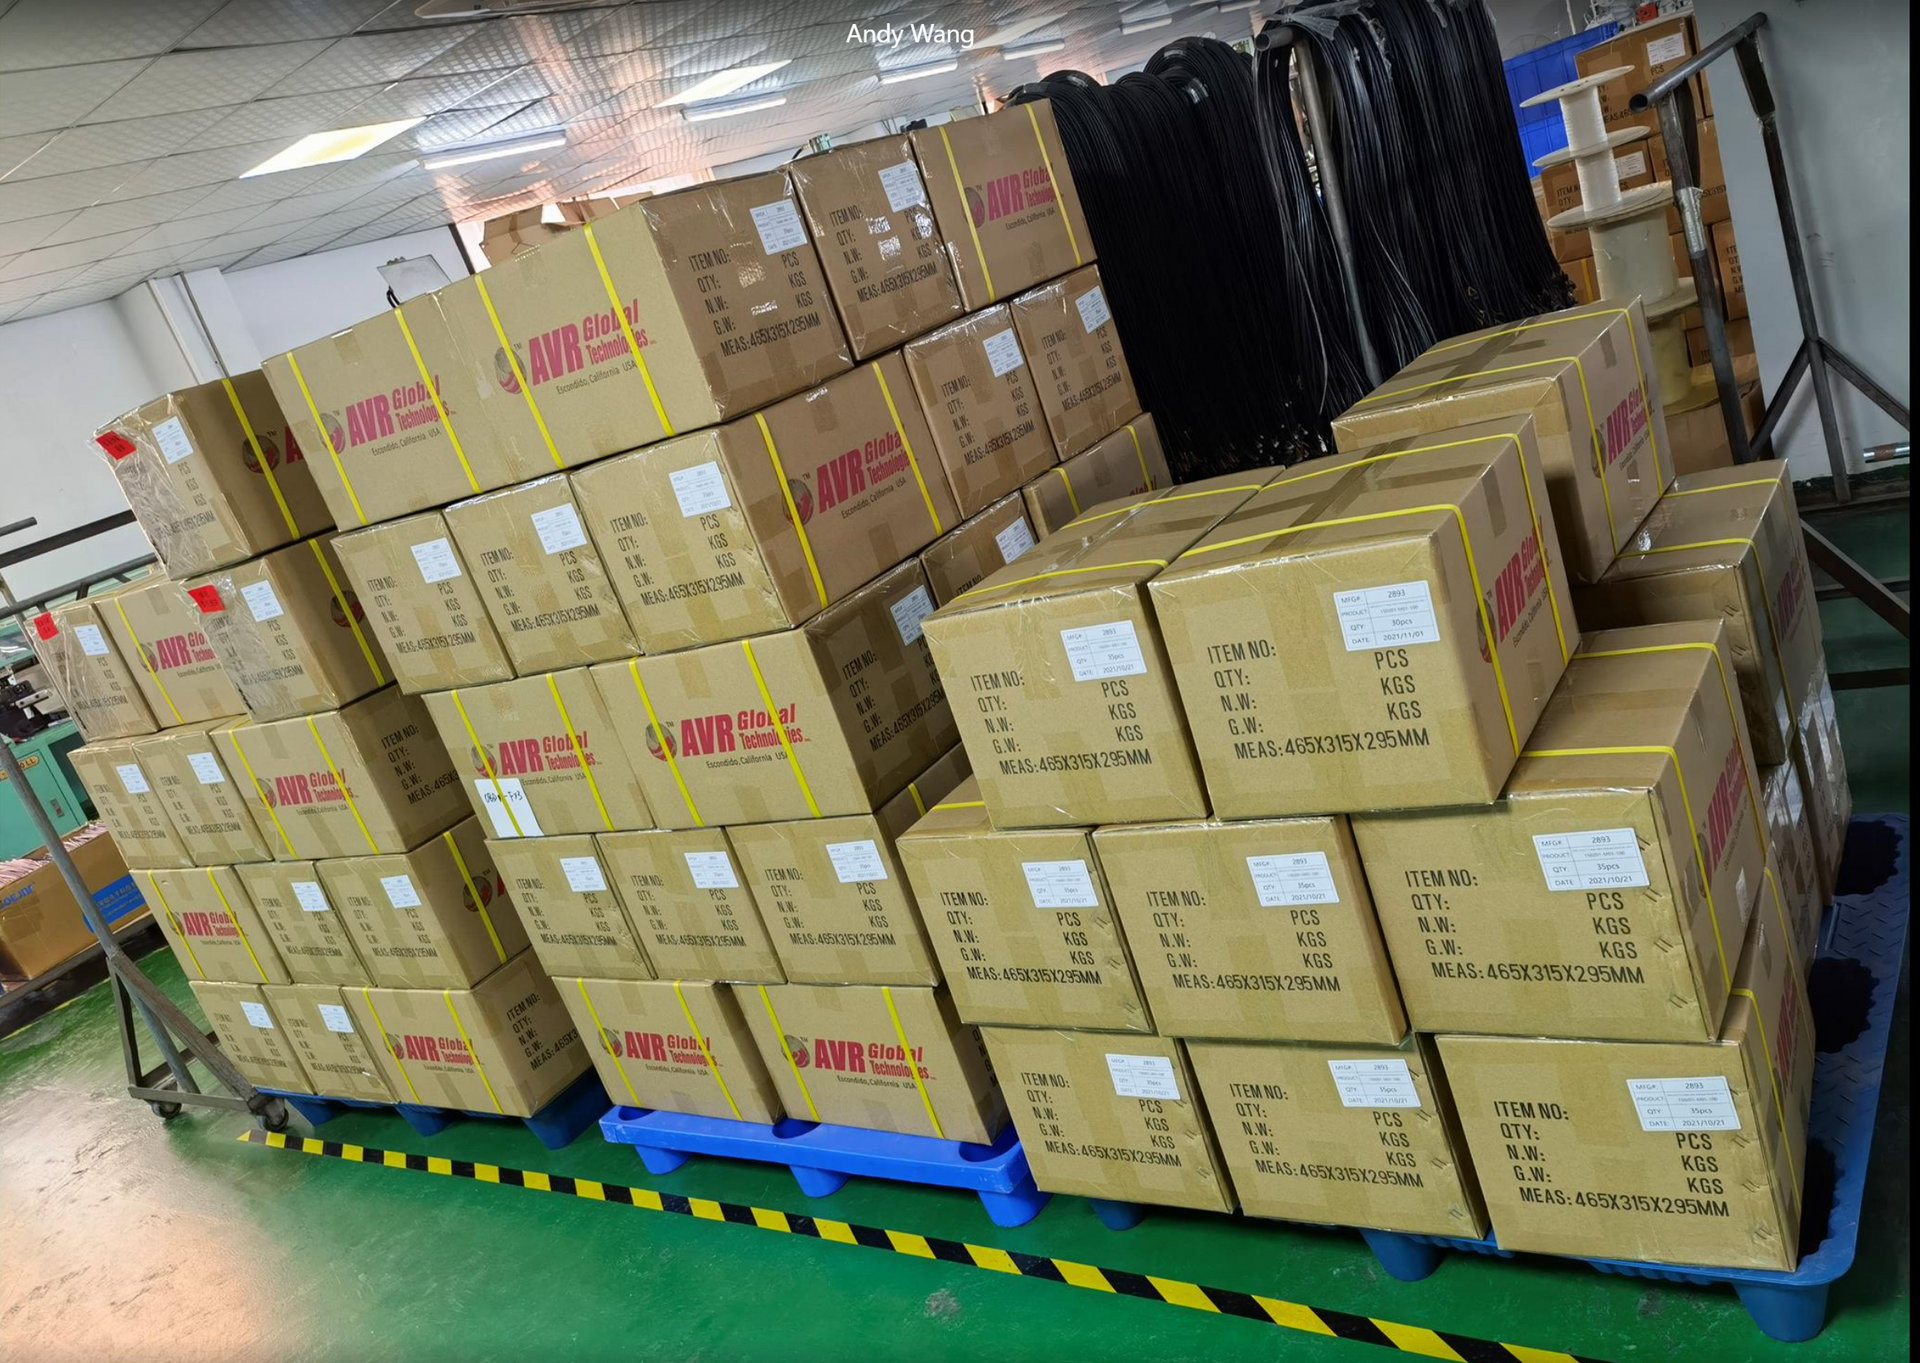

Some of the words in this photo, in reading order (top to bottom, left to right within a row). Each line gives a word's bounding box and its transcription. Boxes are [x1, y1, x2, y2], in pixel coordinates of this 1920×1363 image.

[987, 174, 1024, 221] AVR
[1023, 165, 1052, 188] Globa
[688, 251, 715, 272] ITEM
[711, 248, 732, 266] NO:
[696, 274, 722, 294] QTY:
[780, 250, 800, 269] PCS
[704, 295, 729, 315] N.W:
[787, 270, 807, 289] KGS
[712, 316, 736, 336] G.W:
[794, 290, 814, 309] KGS
[528, 323, 584, 386] AVR
[556, 377, 591, 395] Escondido,
[589, 366, 620, 383] California
[622, 360, 637, 372] USA
[346, 394, 395, 447] AVR
[428, 427, 442, 439] USA
[1607, 398, 1631, 465] AVR
[816, 449, 866, 514] AVR
[864, 427, 904, 464] Globa
[841, 498, 870, 519] Escondido,
[869, 485, 894, 503] California
[896, 477, 907, 488] USA
[1388, 589, 1406, 598] 2893
[1495, 552, 1526, 644] AVR
[1383, 631, 1424, 641] 2021/11/01
[1392, 619, 1413, 627] 30pcs
[156, 635, 193, 670] AVR
[1207, 642, 1246, 664] ITEM
[1247, 639, 1276, 659] NO:
[970, 672, 1002, 692] ITEM
[1000, 670, 1025, 688] NO:
[1213, 668, 1251, 689] QTY:
[1374, 648, 1409, 670] PCS
[977, 695, 1008, 713] QTY:
[1100, 679, 1130, 698] PCS
[1220, 692, 1257, 712] N.W:
[1380, 674, 1416, 696] KGS
[984, 716, 1014, 734] N.W:
[1107, 702, 1137, 721] KGS
[1227, 716, 1264, 736] G.W:
[1386, 700, 1422, 721] KGS
[681, 714, 736, 757] AVR
[992, 737, 1022, 755] G.W:
[1114, 724, 1144, 742] KGS
[1233, 727, 1430, 760] MEAS:465X315X295MM
[498, 738, 544, 775] AVR
[706, 757, 741, 769] Escondido,
[740, 755, 772, 765] California
[775, 752, 788, 761] US
[998, 747, 1153, 775] MEAS:465X315X295MM
[275, 774, 313, 806] AVR
[1592, 836, 1611, 844] 2893
[1404, 870, 1446, 888] ITEM
[1447, 869, 1479, 887] NO:
[1589, 875, 1633, 885] 2021/10/21
[1597, 863, 1620, 871] 35pcs
[939, 891, 968, 906] ITEM
[967, 891, 989, 906] NO:
[1146, 890, 1180, 907] ITEM
[1180, 890, 1206, 907] NO:
[1411, 893, 1450, 911] QTY:
[1585, 891, 1624, 911] PCS
[182, 912, 213, 936] AVR
[946, 910, 973, 925] QTY:
[1056, 911, 1082, 927] PCS
[1152, 912, 1185, 928] QTY:
[1289, 909, 1321, 926] PCS
[1417, 916, 1457, 933] N.W:
[1592, 916, 1631, 935] KGS
[952, 929, 980, 944] N.W:
[1062, 931, 1089, 946] KGS
[1158, 933, 1191, 948] N.W:
[1296, 931, 1327, 948] KGS
[1425, 938, 1463, 956] G.W:
[1598, 941, 1638, 959] KGS
[960, 947, 987, 962] G.W:
[1069, 950, 1095, 966] KGS
[1166, 952, 1198, 968] G.W:
[1302, 952, 1333, 969] KGS
[966, 966, 1103, 985] MEAS:465X315X295MM
[1172, 973, 1341, 992] MEAS:465X315X295MM
[1431, 961, 1645, 984] MEAS:465X315X295MM
[404, 1035, 441, 1061] AVR
[624, 1031, 667, 1062] AVR
[667, 1034, 710, 1051] Globl
[815, 1039, 866, 1073] AVR
[837, 1075, 870, 1086] Escondido,
[870, 1078, 899, 1088] California
[1020, 1072, 1049, 1087] ITEM
[1048, 1073, 1070, 1089] NO:
[1229, 1083, 1263, 1099] ITEM
[1263, 1084, 1289, 1100] NO:
[1026, 1089, 1054, 1104] QTY:
[1138, 1098, 1164, 1114] PCS
[1493, 1100, 1536, 1119] ITEM
[1537, 1102, 1570, 1121] NO:
[1032, 1106, 1059, 1121] N.W:
[1143, 1116, 1170, 1132] KGS
[1235, 1102, 1268, 1118] QTY:
[1372, 1110, 1403, 1128] PCS
[1038, 1122, 1065, 1138] G.W:
[1149, 1134, 1176, 1150] KGS
[1241, 1121, 1274, 1137] N.W:
[1378, 1131, 1410, 1148] KGS
[1499, 1122, 1540, 1141] QTY:
[1675, 1132, 1713, 1151] PCS
[1044, 1140, 1182, 1167] MEAS:465X315X295MM
[1248, 1139, 1280, 1156] G.W:
[1385, 1151, 1417, 1168] KGS
[1505, 1144, 1546, 1162] N.W:
[1680, 1155, 1719, 1173] KGS
[1254, 1159, 1424, 1188] MEAS:465X315X295MM
[1513, 1165, 1552, 1183] G.W:
[1686, 1177, 1724, 1195] KGS
[1518, 1186, 1730, 1217] MEAS:465X315X295MM
